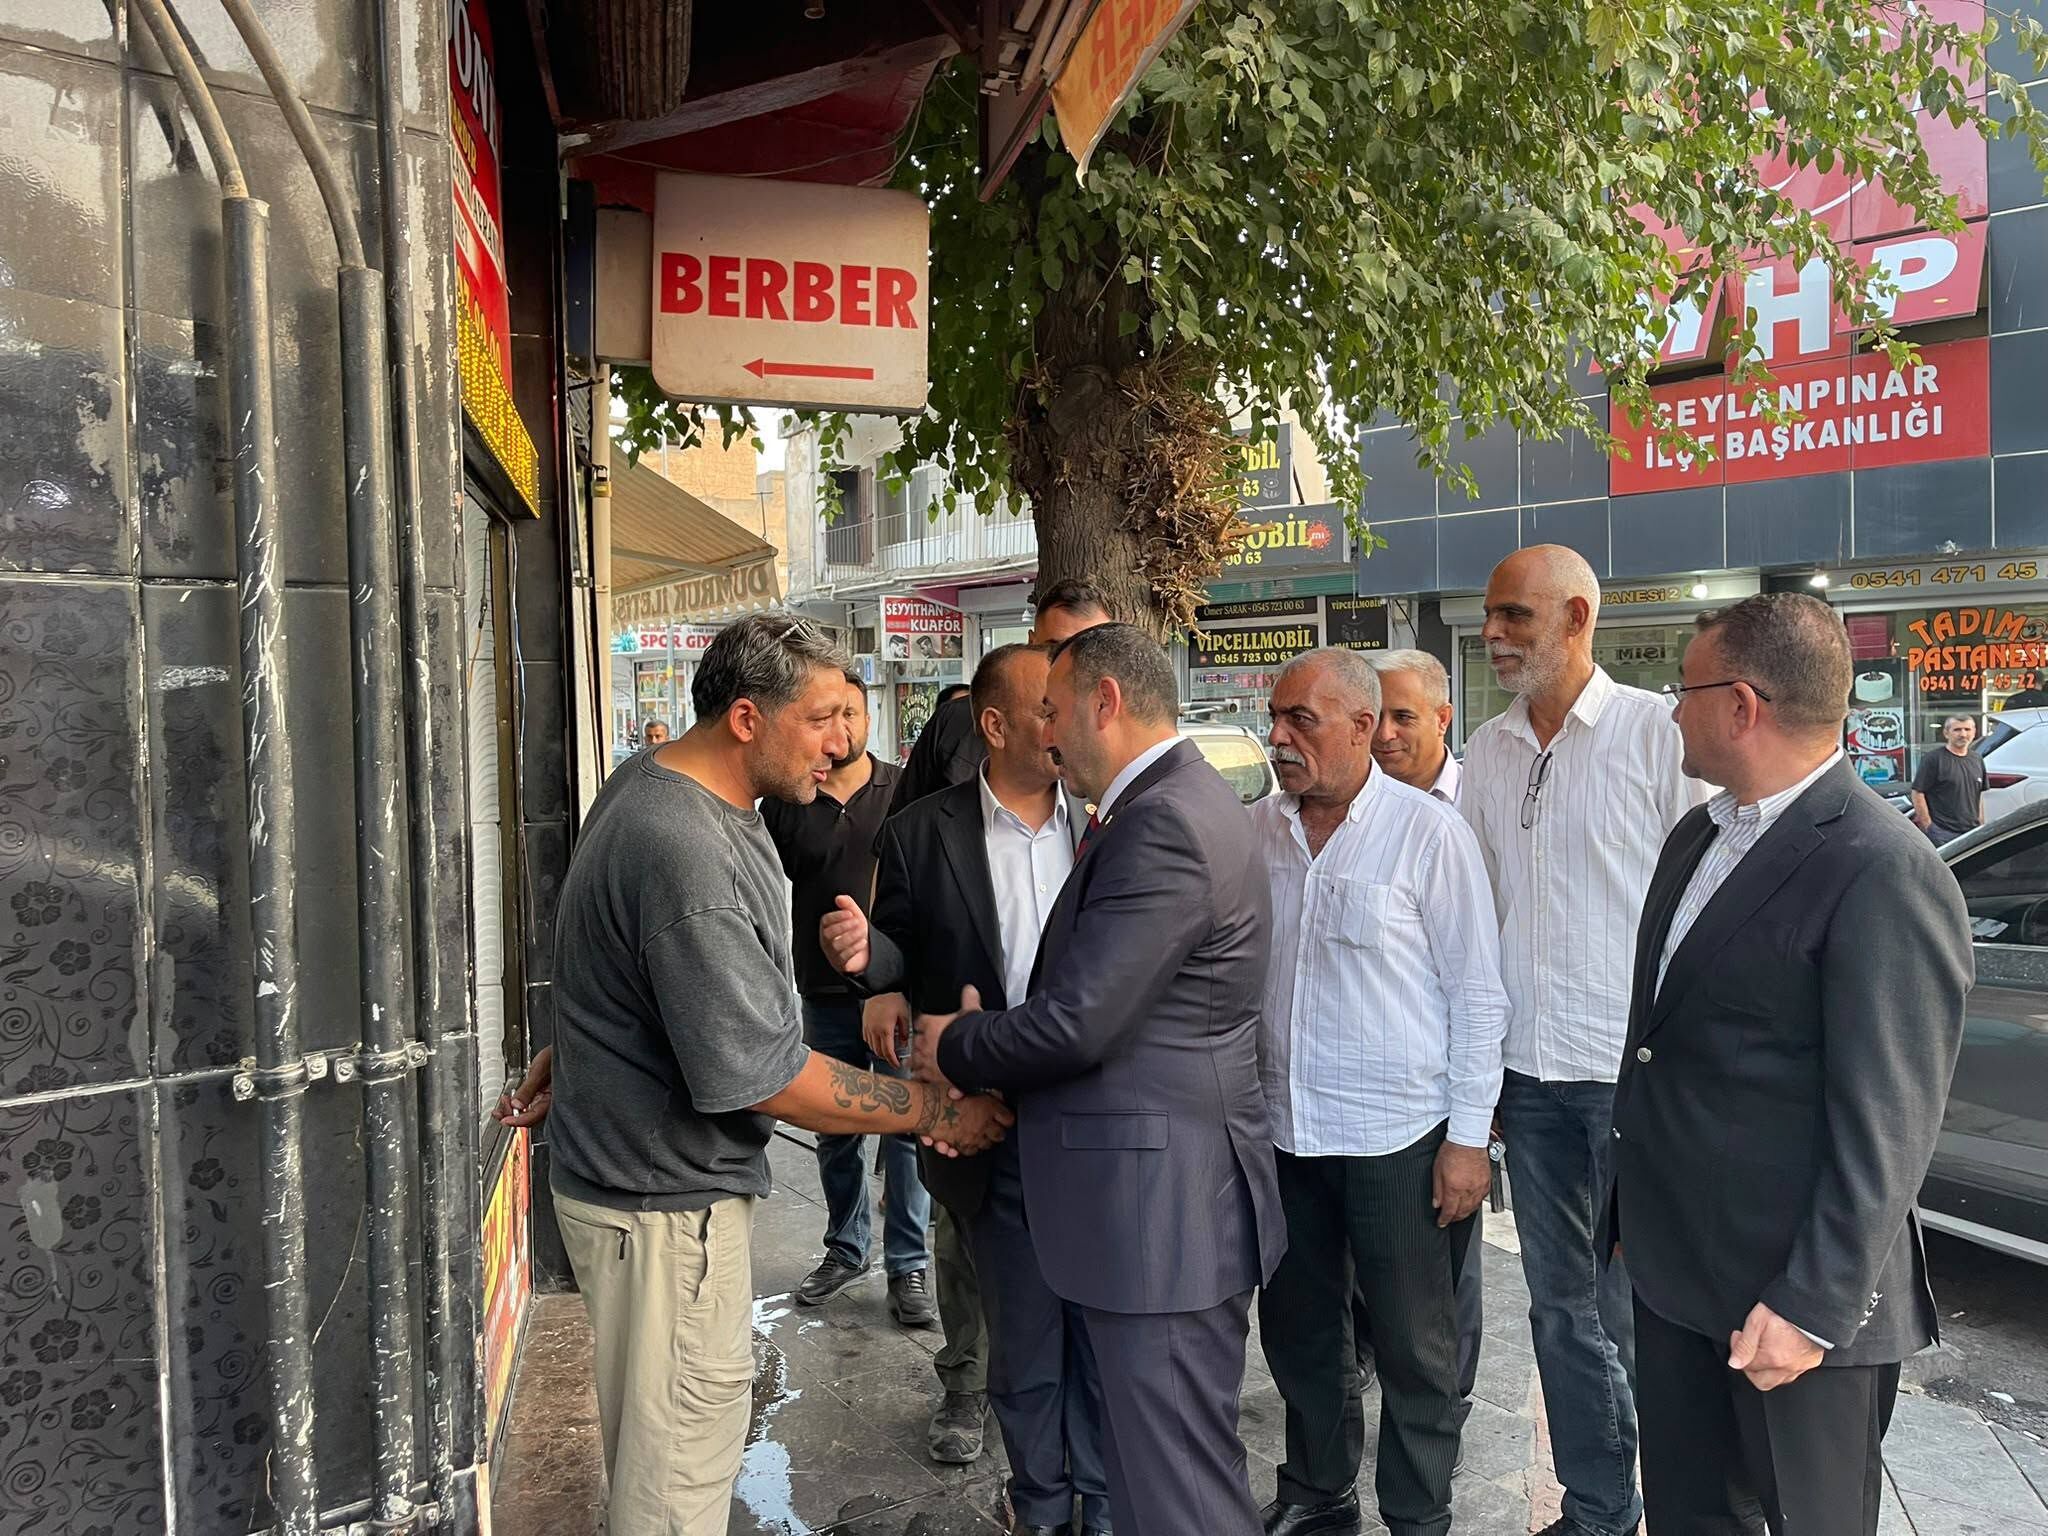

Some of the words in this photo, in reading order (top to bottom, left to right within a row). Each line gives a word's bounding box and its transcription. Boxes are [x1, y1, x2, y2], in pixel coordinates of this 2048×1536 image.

[659, 252, 919, 330] BERBER
[1655, 364, 1940, 431] CEYLANPINAR
[1726, 401, 1942, 462] BAŞKANLIĞI
[1245, 551, 1262, 565] 63
[1851, 569, 1921, 589] 0541
[1931, 565, 1985, 585] 471
[1998, 562, 2038, 580] 45
[886, 600, 944, 616] SEYYİTHAN
[1283, 601, 1295, 610] 00
[1295, 600, 1305, 609] 63
[910, 616, 961, 631] KUAFÖR
[1908, 608, 2029, 647] TADIM
[1214, 653, 1240, 664] 0545
[1242, 652, 1261, 663] 723
[1263, 652, 1278, 662] 00
[1920, 674, 1954, 691] 0541
[2016, 672, 2036, 688] 22
